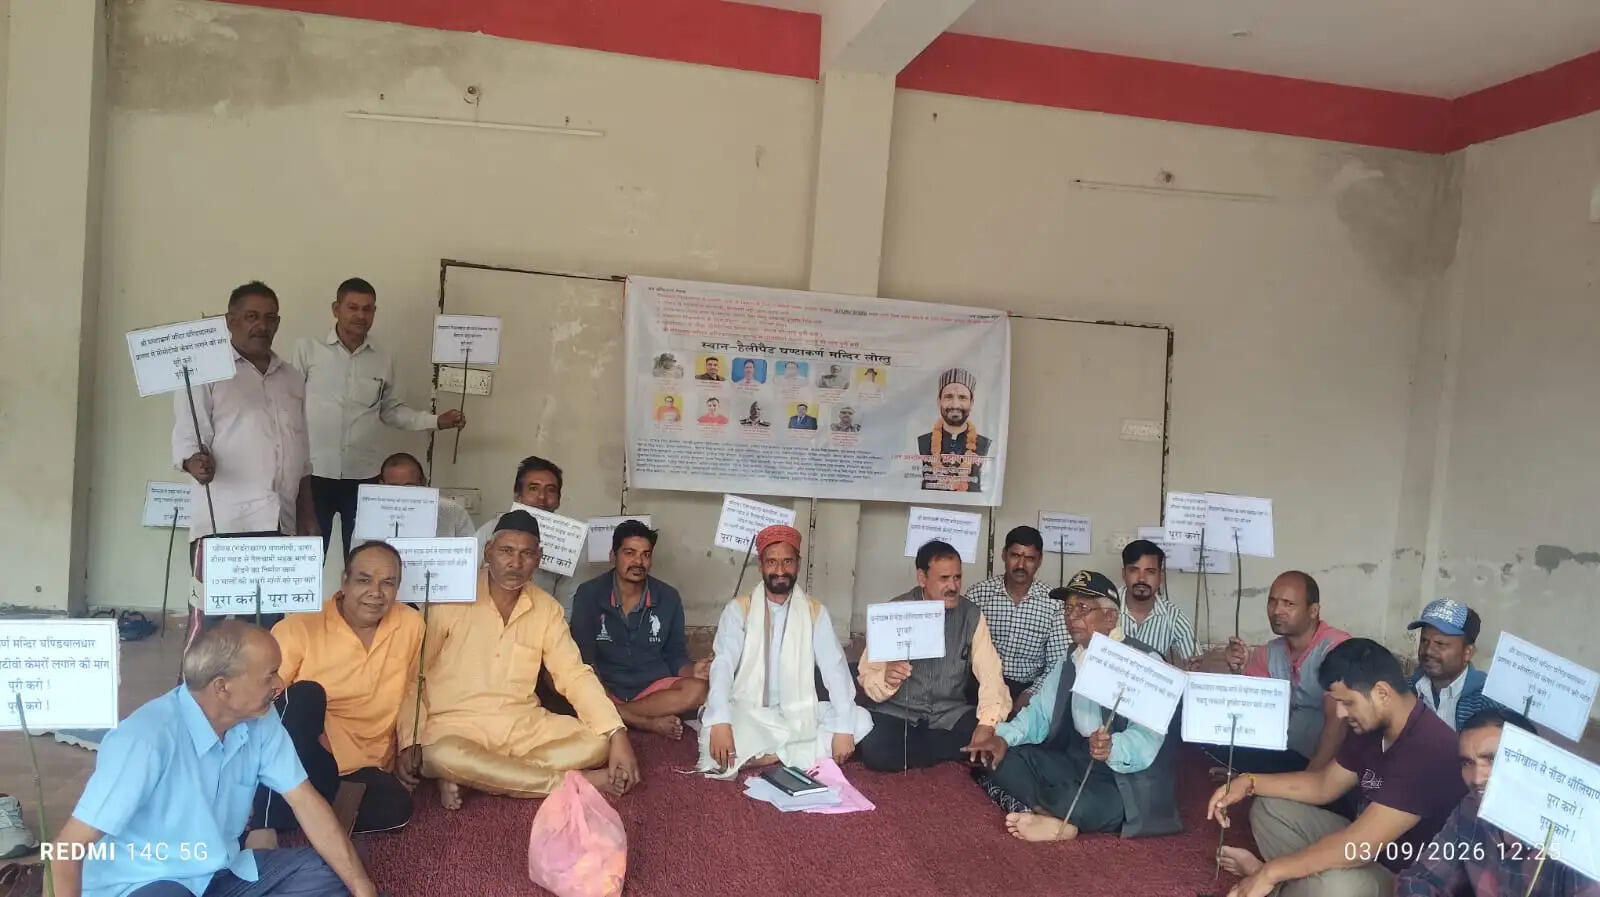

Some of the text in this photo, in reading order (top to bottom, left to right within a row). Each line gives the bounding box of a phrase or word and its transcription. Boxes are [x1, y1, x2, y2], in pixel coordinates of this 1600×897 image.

[828, 348, 860, 361] मन्दिर
[211, 595, 232, 609] पूरा
[268, 593, 288, 607] पूरा
[291, 589, 316, 603] करो
[13, 636, 37, 649] मन्दिर
[51, 657, 76, 669] लगाने
[78, 656, 91, 669] की
[94, 657, 110, 669] मांग
[8, 677, 23, 693] पूरी
[25, 677, 43, 691] करो
[24, 697, 42, 712] करो
[1540, 760, 1548, 774] से
[1547, 793, 1560, 808] पूरा
[1561, 800, 1577, 816] करो
[1554, 822, 1569, 839] करो
